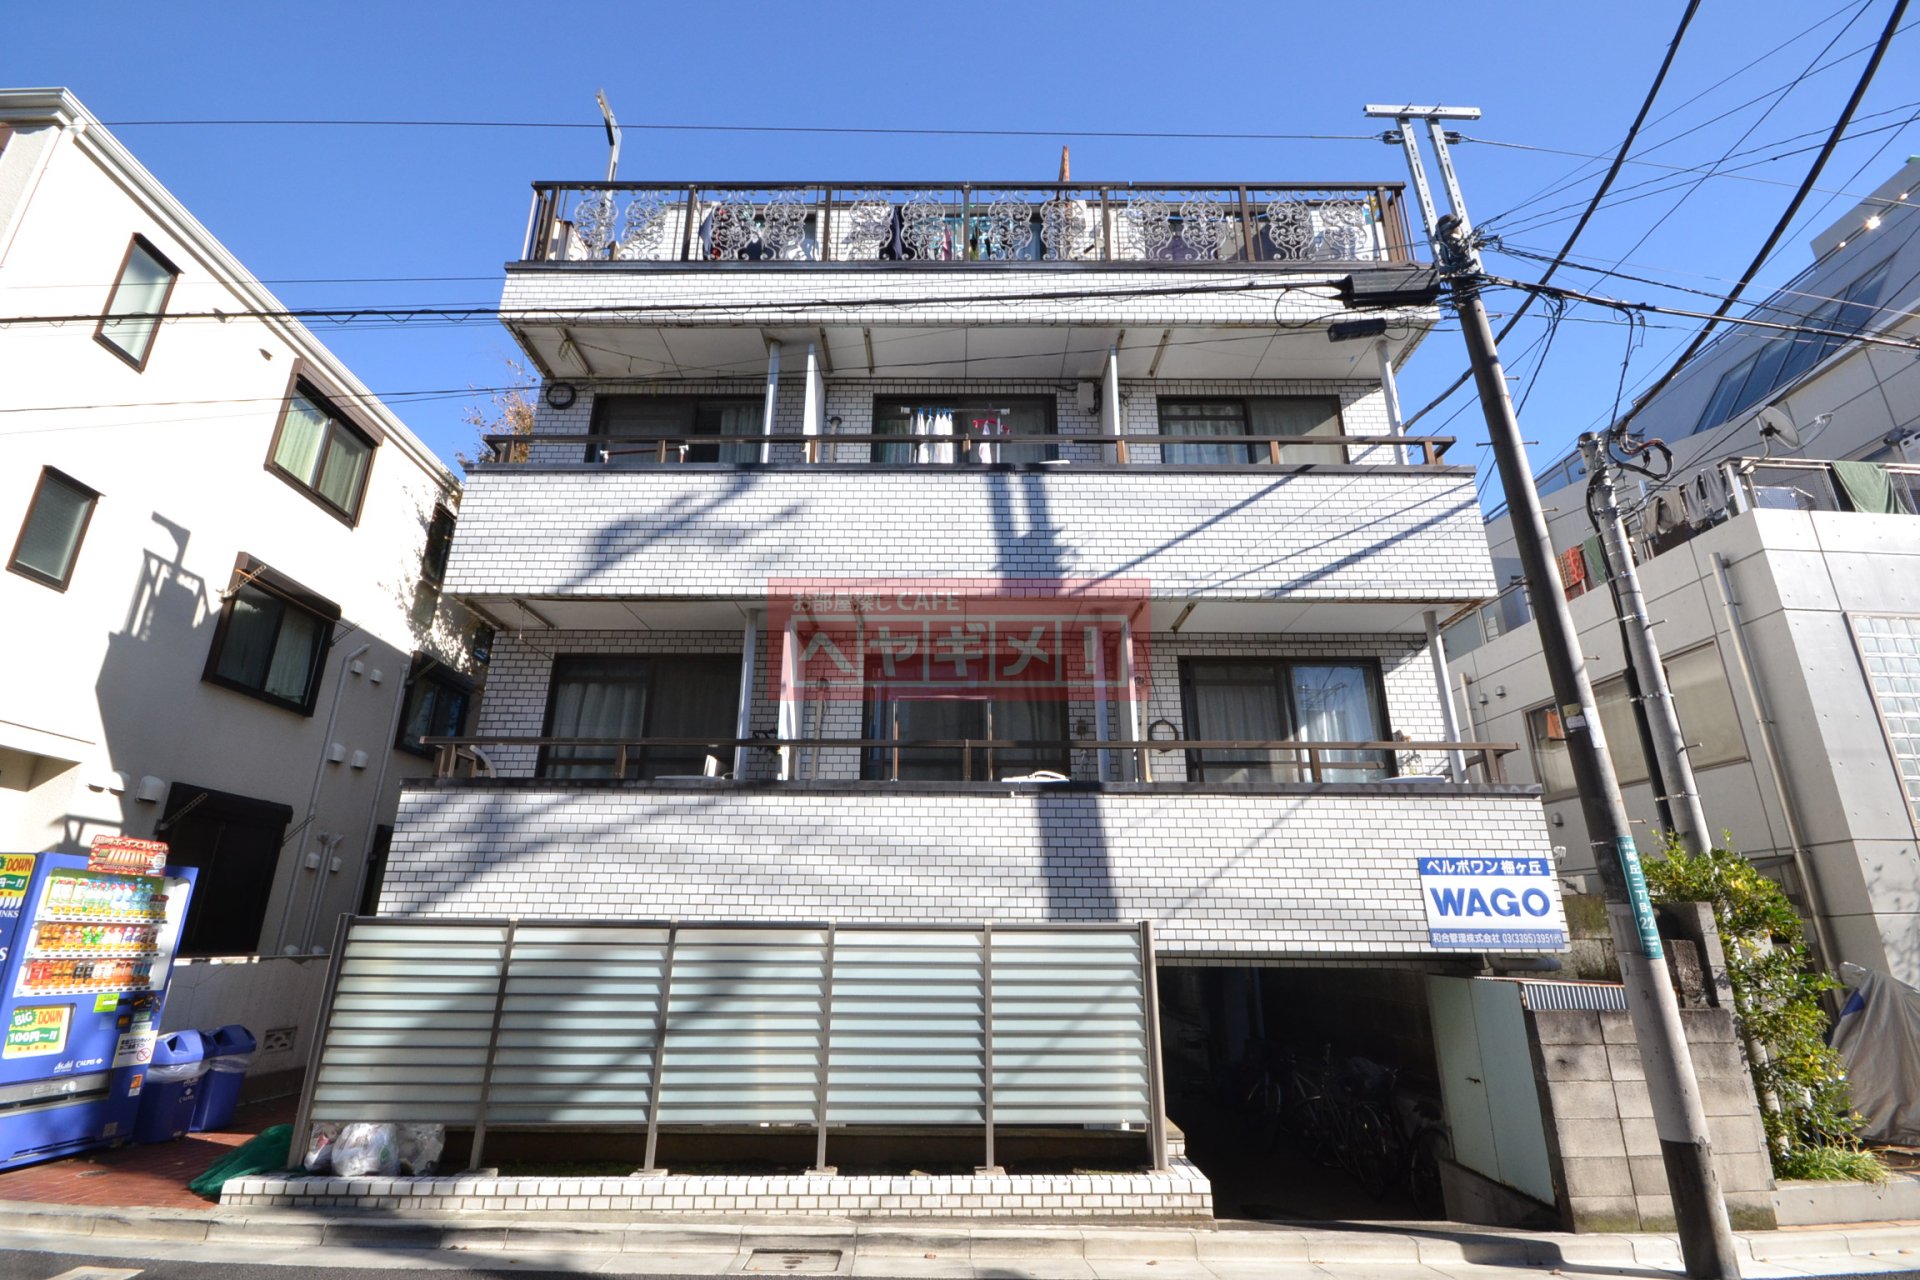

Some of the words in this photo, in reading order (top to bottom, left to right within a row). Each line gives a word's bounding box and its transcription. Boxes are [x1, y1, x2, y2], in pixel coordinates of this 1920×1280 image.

[5, 857, 33, 872] DOWN
[1429, 887, 1551, 918] WAGO
[1639, 917, 1656, 930] 22
[1432, 932, 1501, 945] 和合管理株式会社
[14, 1011, 34, 1026] BIG
[37, 1010, 63, 1025] DOWN
